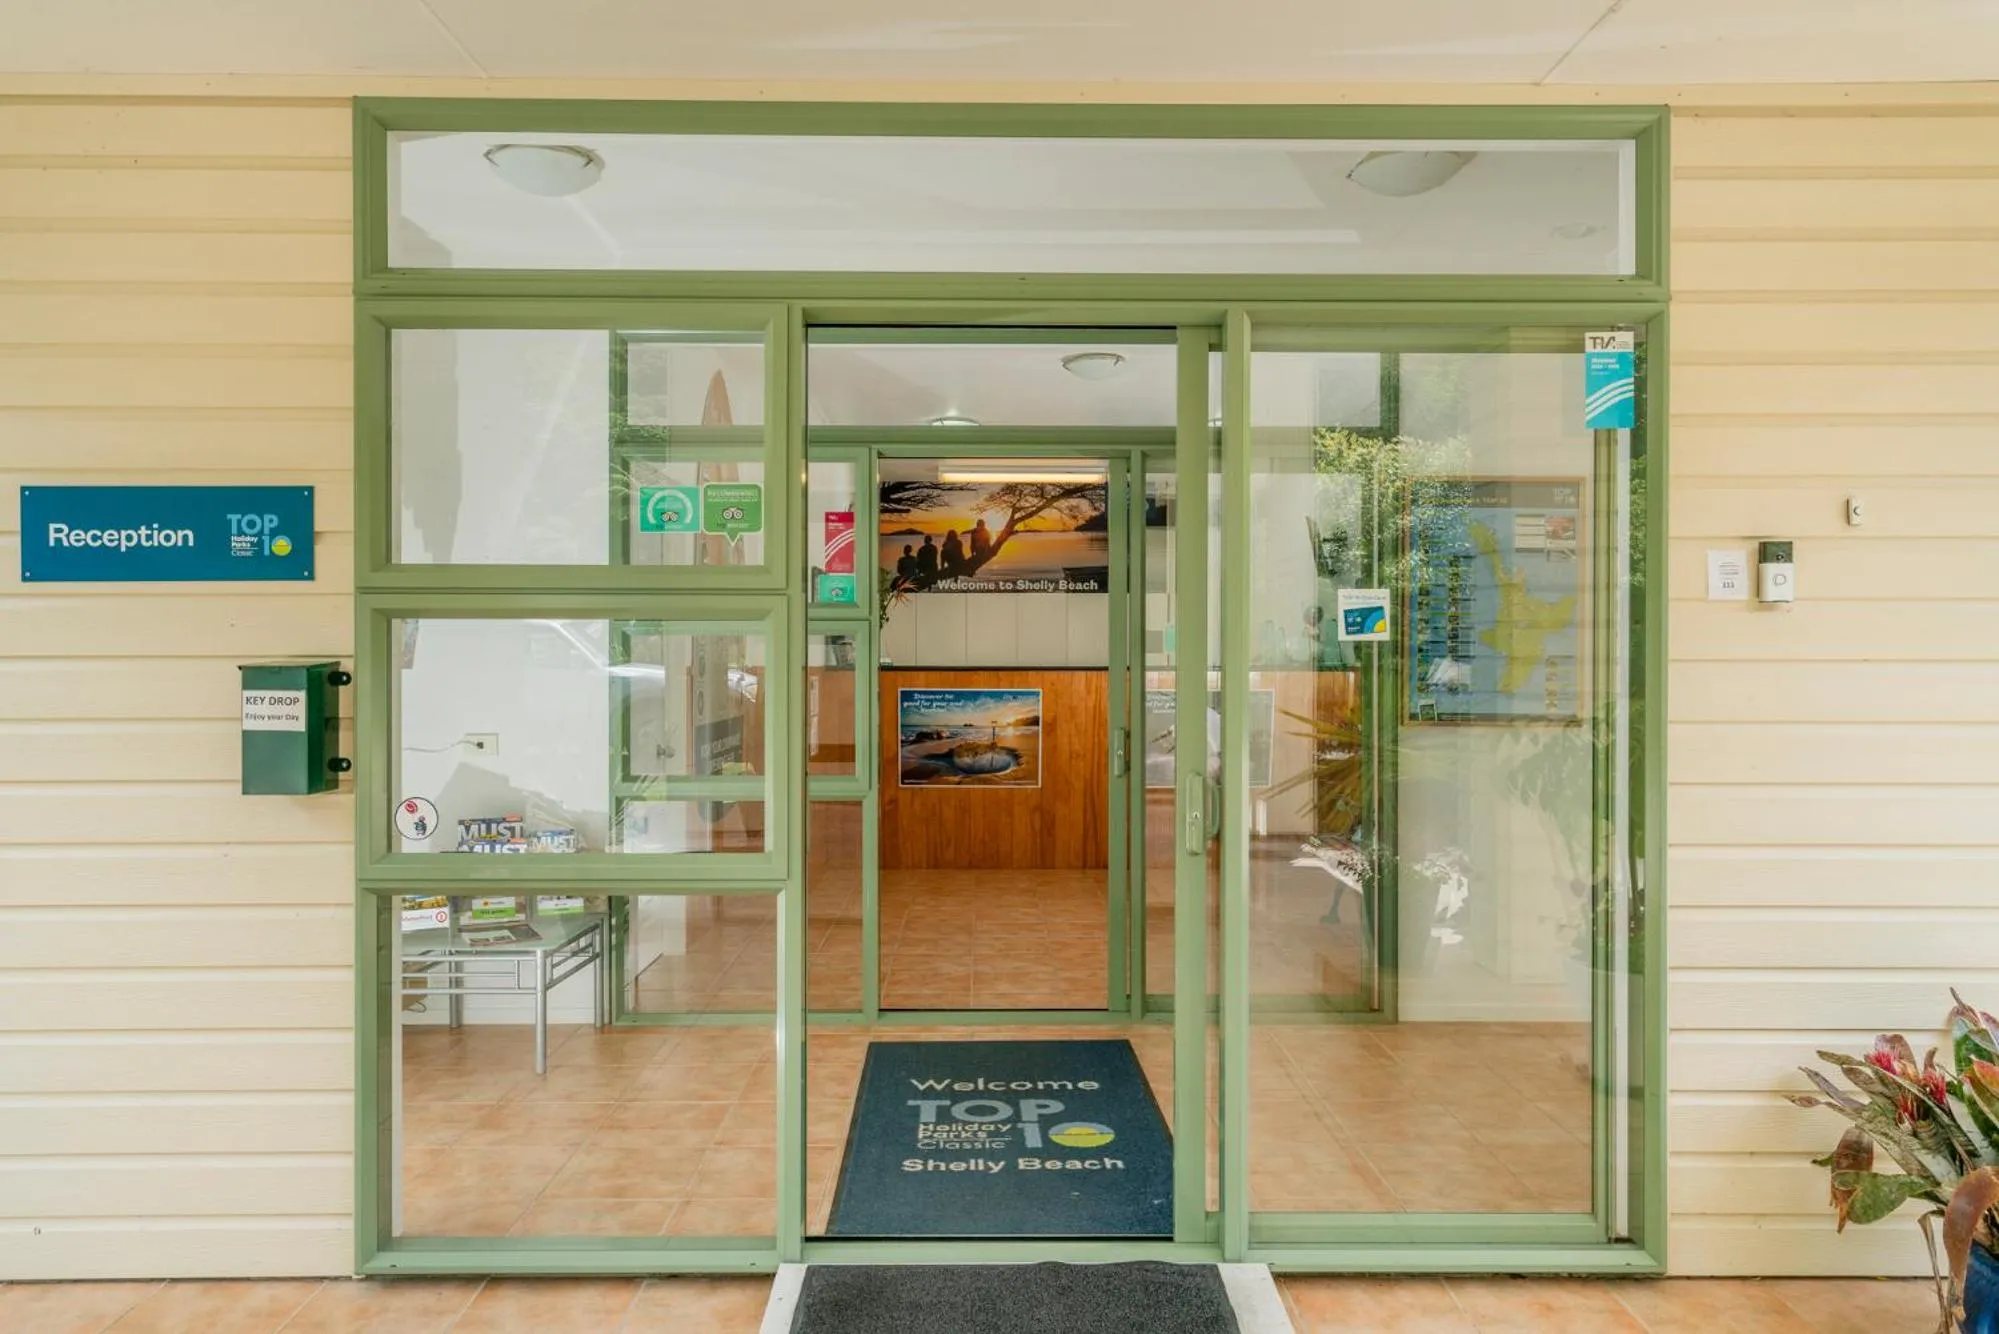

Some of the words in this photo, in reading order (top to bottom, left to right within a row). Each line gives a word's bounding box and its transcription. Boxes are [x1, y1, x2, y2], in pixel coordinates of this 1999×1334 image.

[226, 514, 279, 534] TOP
[48, 522, 195, 552] Reception
[937, 579, 995, 590] Welcome
[999, 580, 1014, 590] to
[1016, 580, 1055, 592] Shelly
[1058, 580, 1099, 590] Beach
[245, 696, 266, 705] KEY
[268, 696, 300, 706] DROP
[459, 822, 523, 841] MUST
[531, 835, 575, 849] MUST
[910, 1078, 1100, 1091] Welcome
[907, 1099, 1065, 1122] TOP
[918, 1123, 1012, 1132] Holiday
[1017, 1121, 1115, 1148] 10
[918, 1131, 987, 1139] Parks
[917, 1140, 1005, 1150] Classic
[902, 1158, 1005, 1173] Shelly
[1018, 1157, 1125, 1170] Beach
